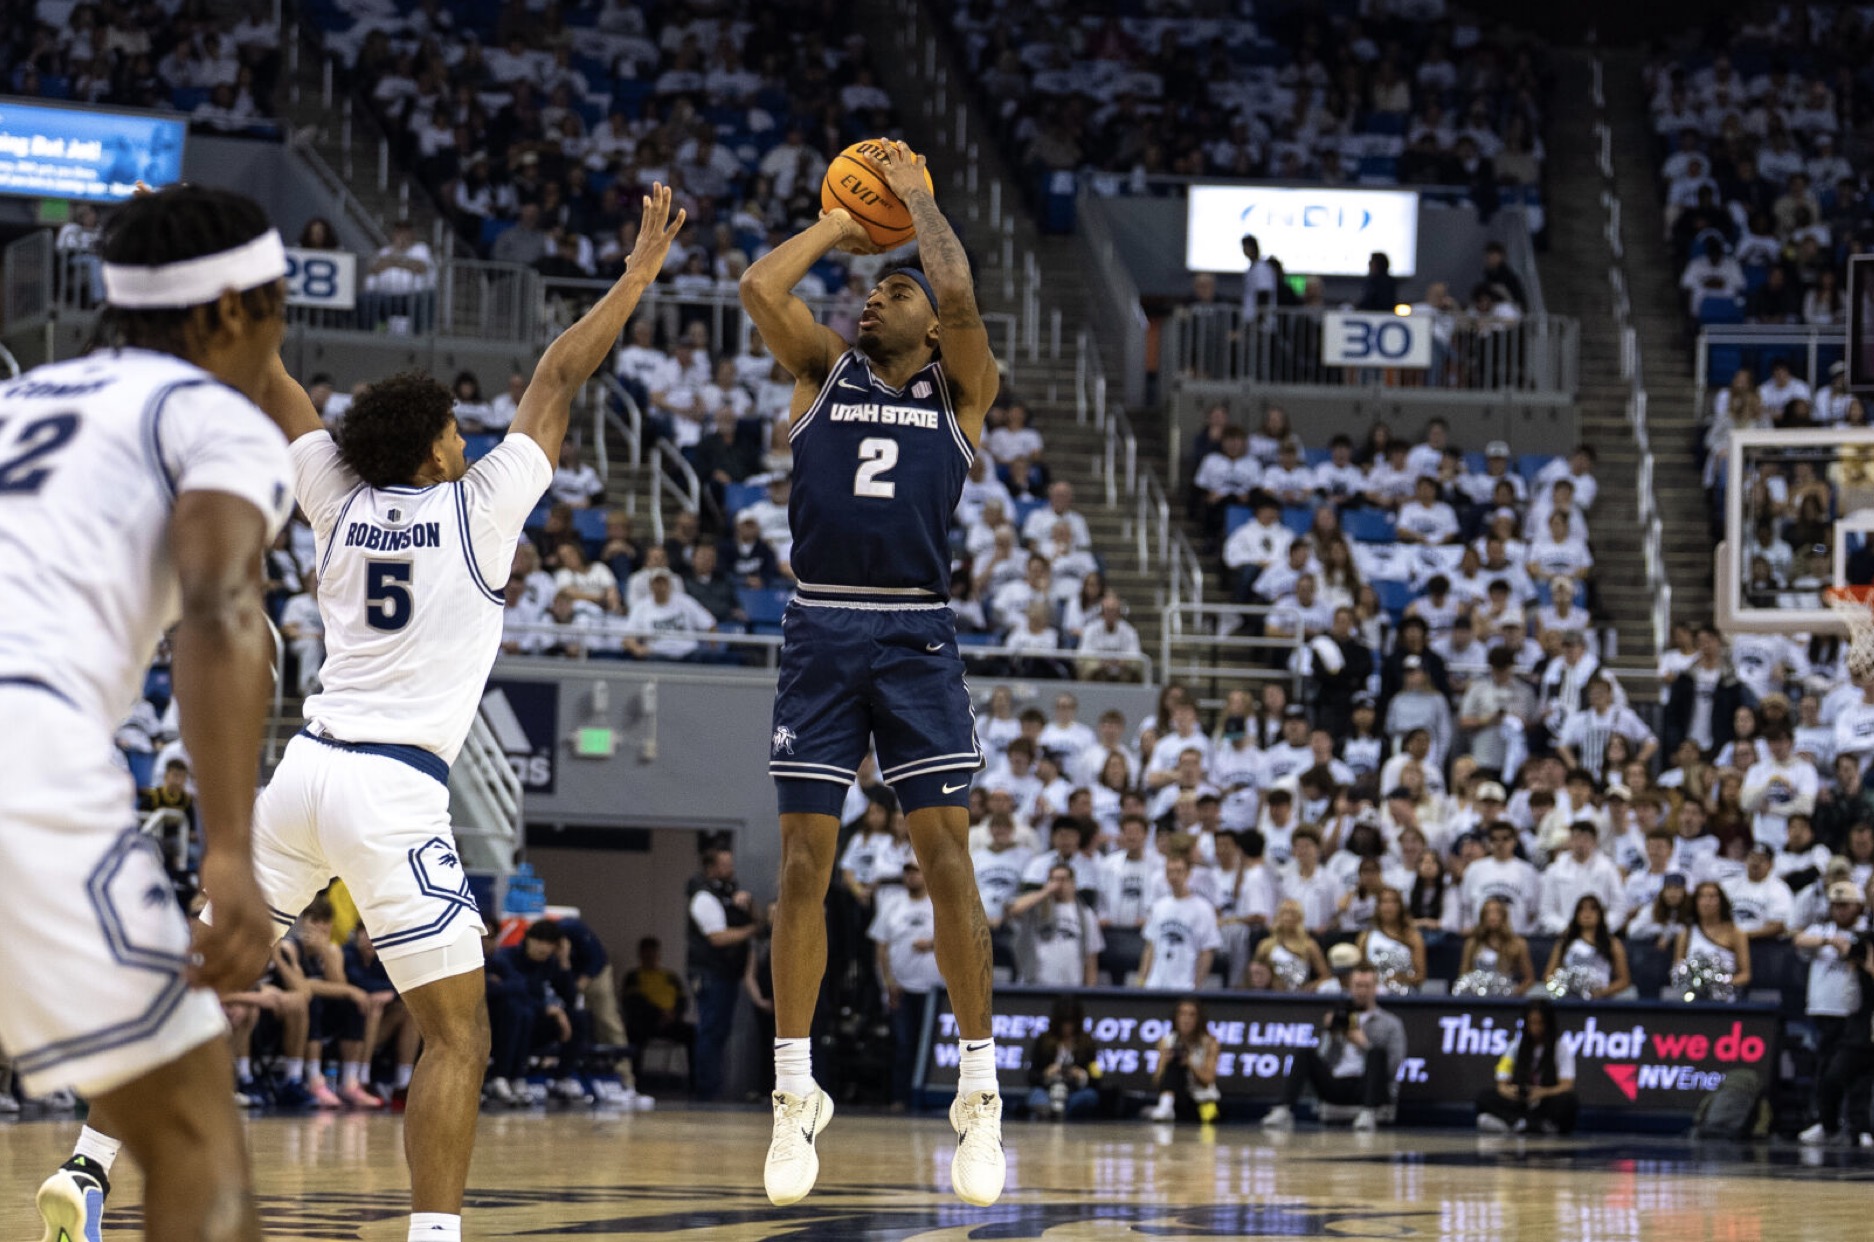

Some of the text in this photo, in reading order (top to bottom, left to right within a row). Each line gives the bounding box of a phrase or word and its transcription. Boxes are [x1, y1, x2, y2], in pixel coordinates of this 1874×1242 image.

[1342, 320, 1413, 360] 30
[829, 402, 939, 430] UTAH STATE
[853, 436, 899, 499] 2
[344, 521, 441, 552] ROBINSON
[364, 558, 415, 635] 5
[938, 1013, 1050, 1038] TRE'S
[1206, 1020, 1245, 1046] HE
[1247, 1021, 1320, 1048] LINE.
[1438, 1013, 1509, 1056] This
[1652, 1033, 1709, 1061] we
[1713, 1020, 1766, 1063] do
[934, 1042, 1024, 1070] WRE
[1238, 1053, 1280, 1078] TO
[1637, 1064, 1726, 1092] NVEne
